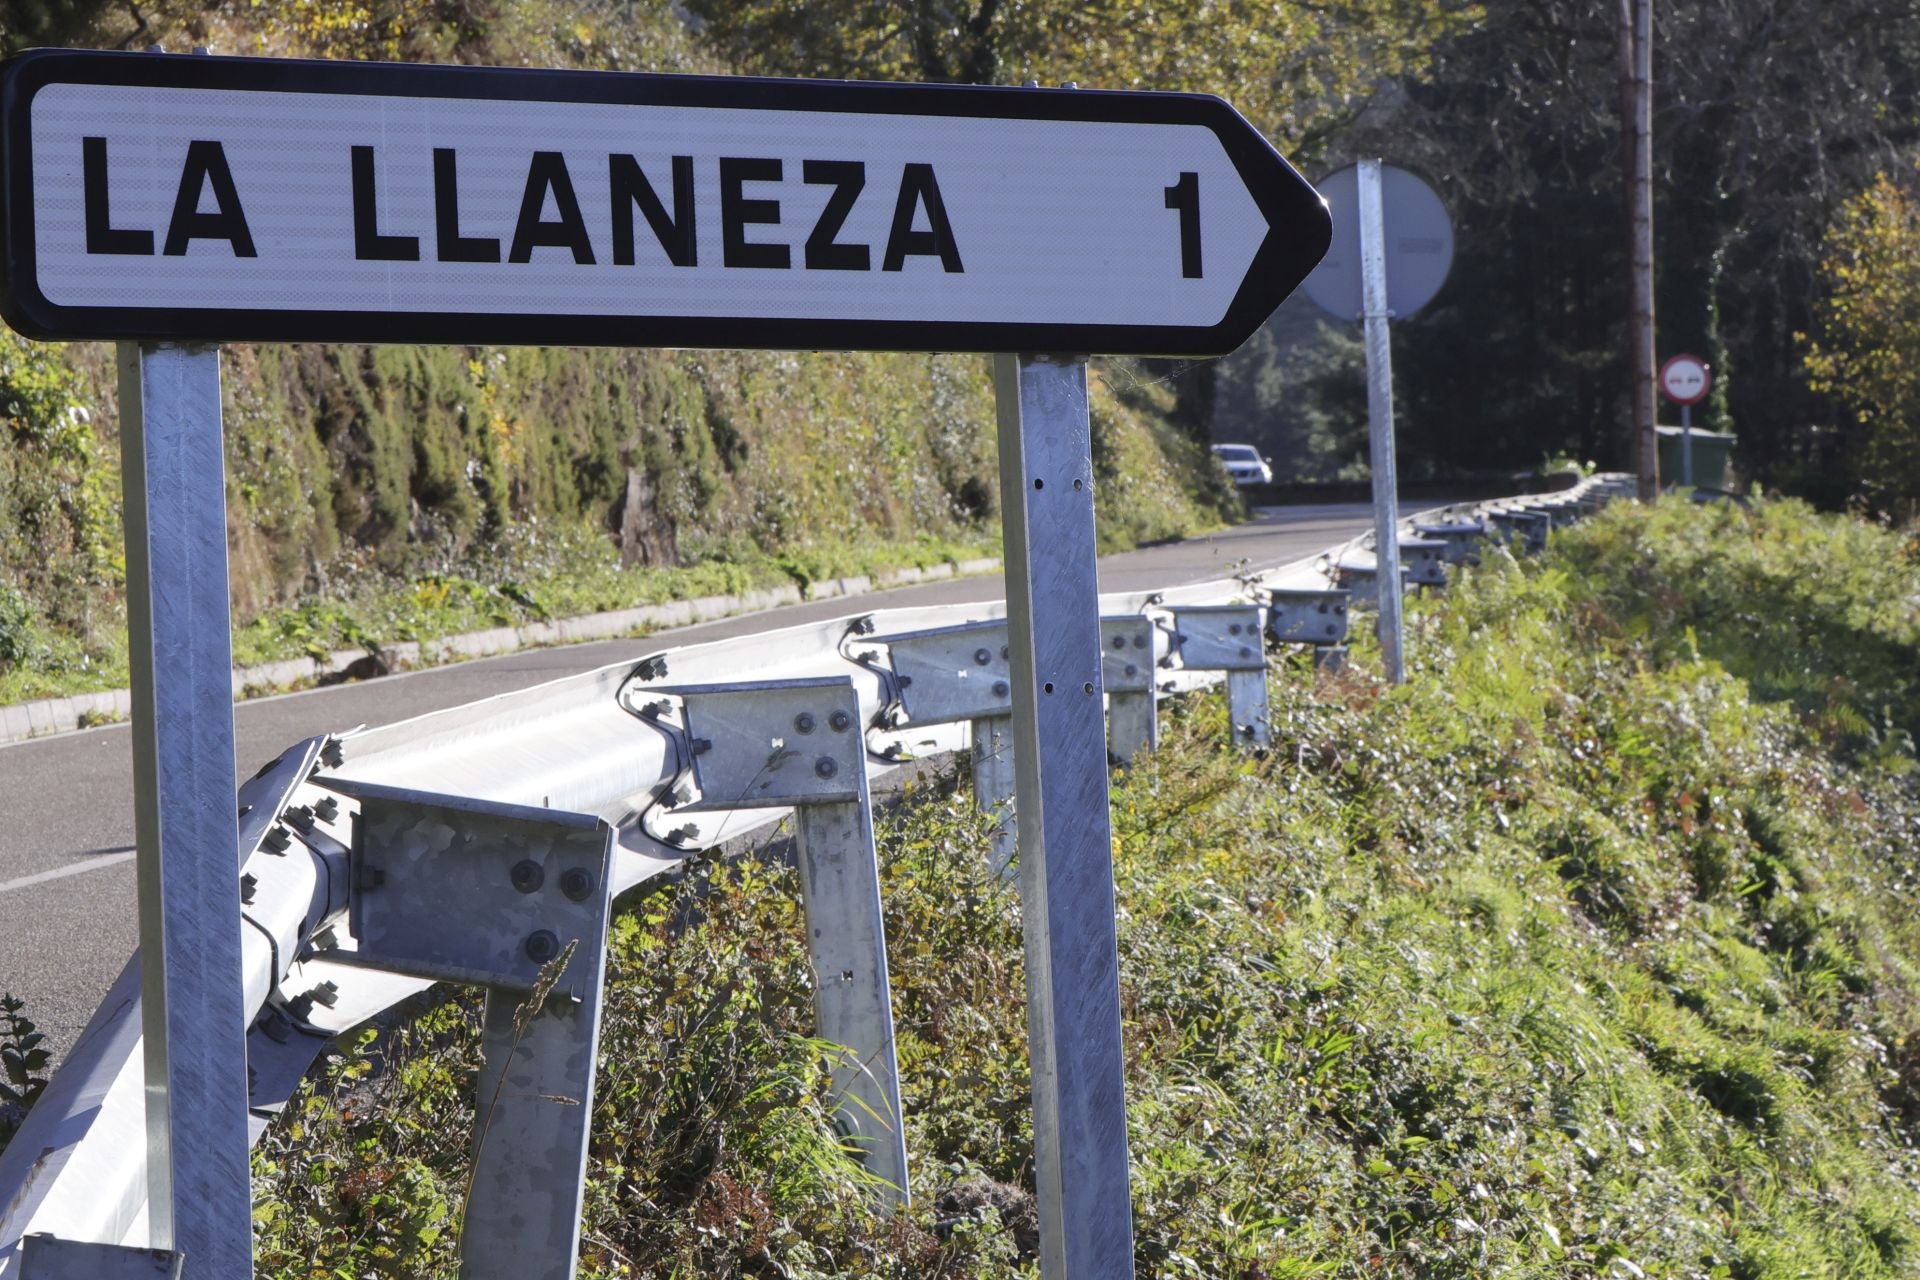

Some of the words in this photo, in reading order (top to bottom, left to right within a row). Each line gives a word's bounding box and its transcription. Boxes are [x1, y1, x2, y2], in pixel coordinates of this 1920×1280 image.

[83, 137, 258, 258] LA
[351, 146, 964, 273] LLANEZA
[1164, 172, 1203, 278] 1
